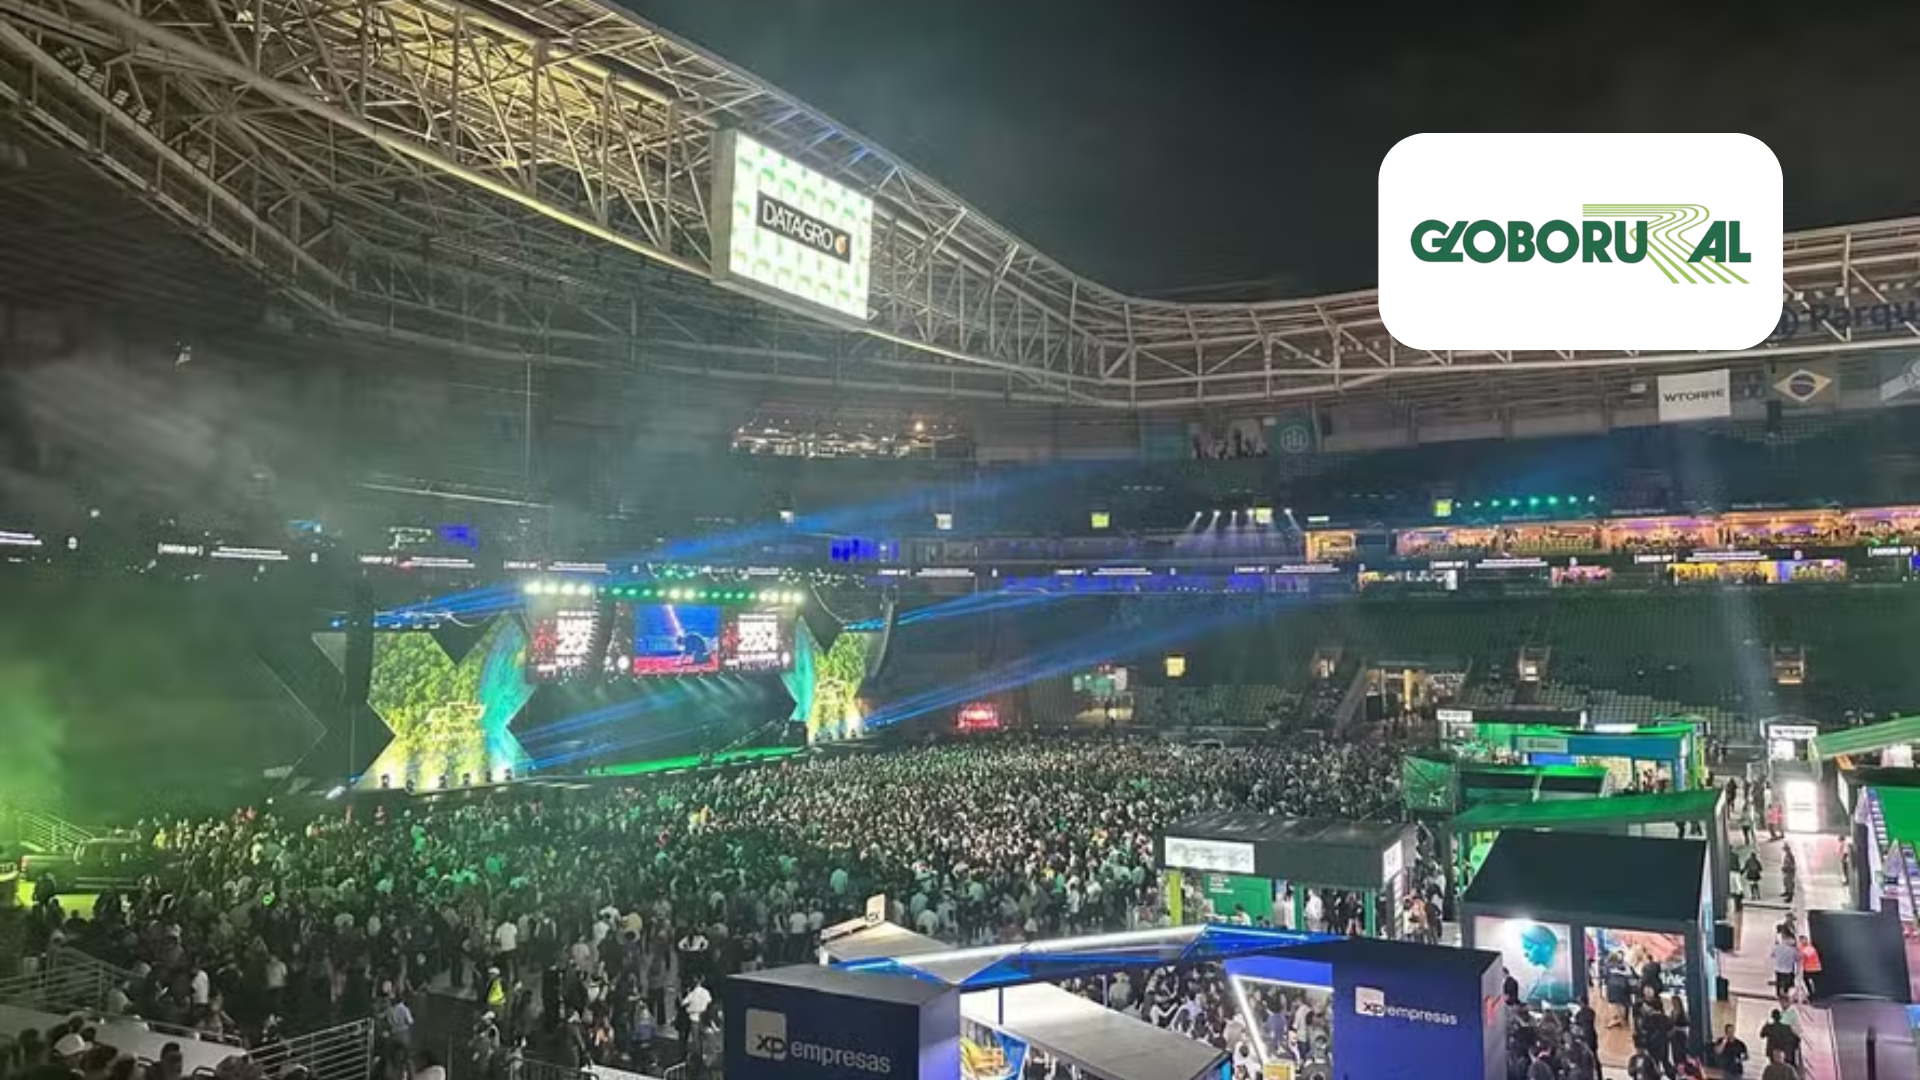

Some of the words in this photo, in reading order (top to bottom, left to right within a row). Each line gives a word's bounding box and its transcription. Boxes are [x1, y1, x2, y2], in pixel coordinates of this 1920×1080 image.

[763, 200, 833, 249] DATAGRO
[1663, 388, 1725, 402] WTORRE
[1387, 1006, 1457, 1025] empresas
[791, 1041, 891, 1073] empresas
